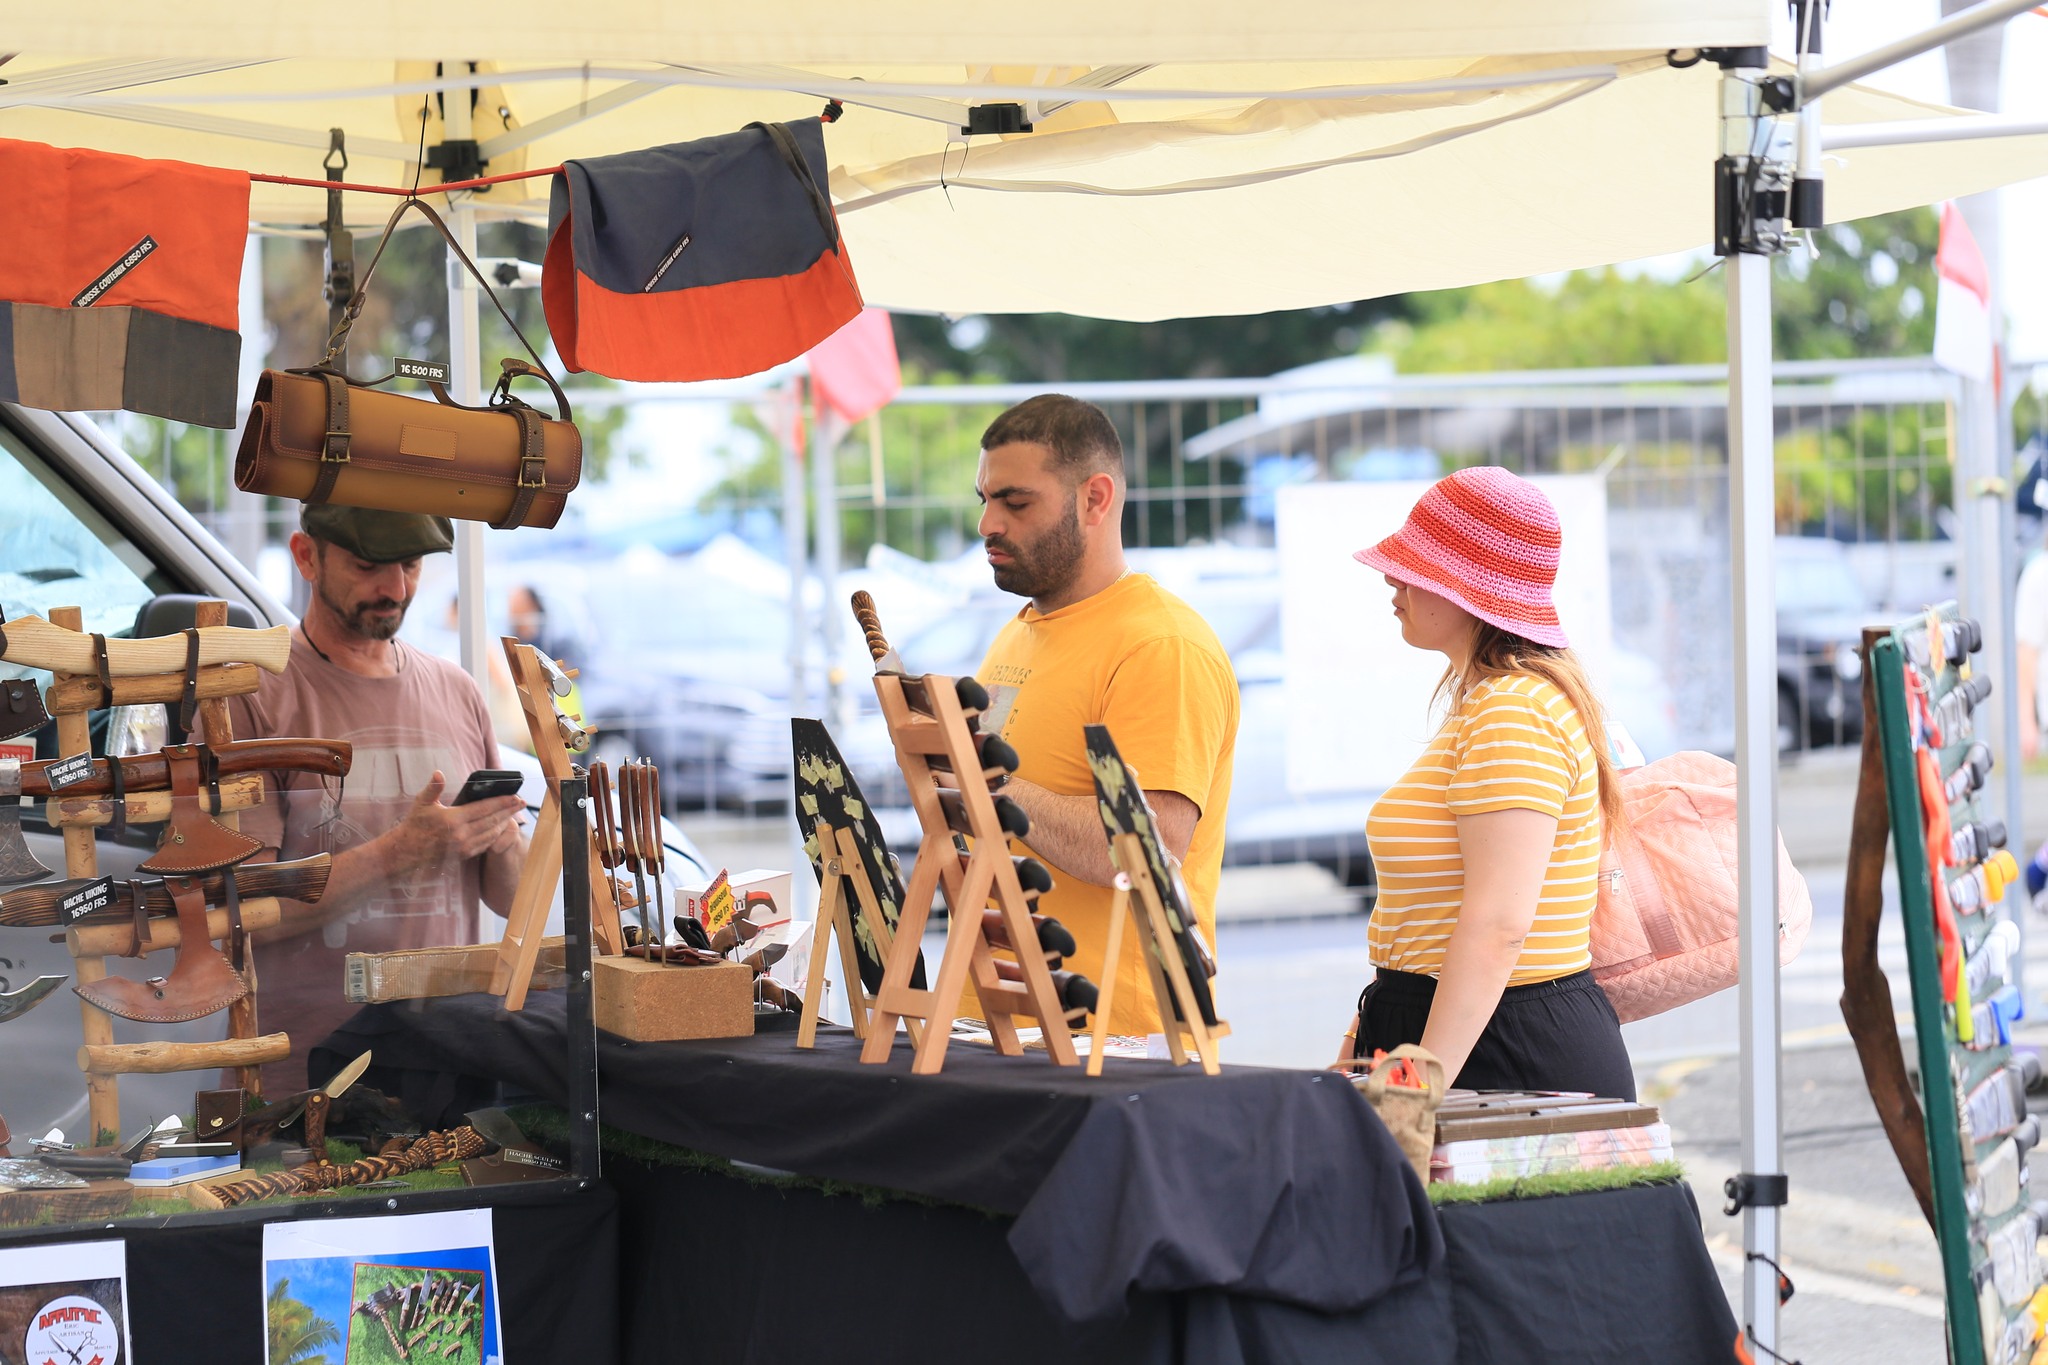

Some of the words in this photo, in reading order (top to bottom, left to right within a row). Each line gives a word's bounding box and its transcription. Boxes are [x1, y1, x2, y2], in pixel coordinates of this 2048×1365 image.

[77, 285, 101, 307] HOUSSE
[98, 262, 127, 290] COUTEAUX
[124, 249, 142, 267] 6850
[139, 240, 153, 254] FRS
[400, 364, 411, 374] 16
[411, 365, 428, 376] 500
[428, 367, 444, 378] FRS
[51, 764, 69, 777] HACHE
[69, 757, 87, 771] VIKING
[57, 772, 77, 785] 16950
[77, 767, 88, 779] FRS
[63, 892, 85, 910] HACHE
[84, 882, 108, 900] VIKING
[71, 901, 93, 919] 16950
[93, 895, 107, 909] FRS
[509, 1150, 533, 1159] HACHE
[539, 1160, 552, 1168] FRS
